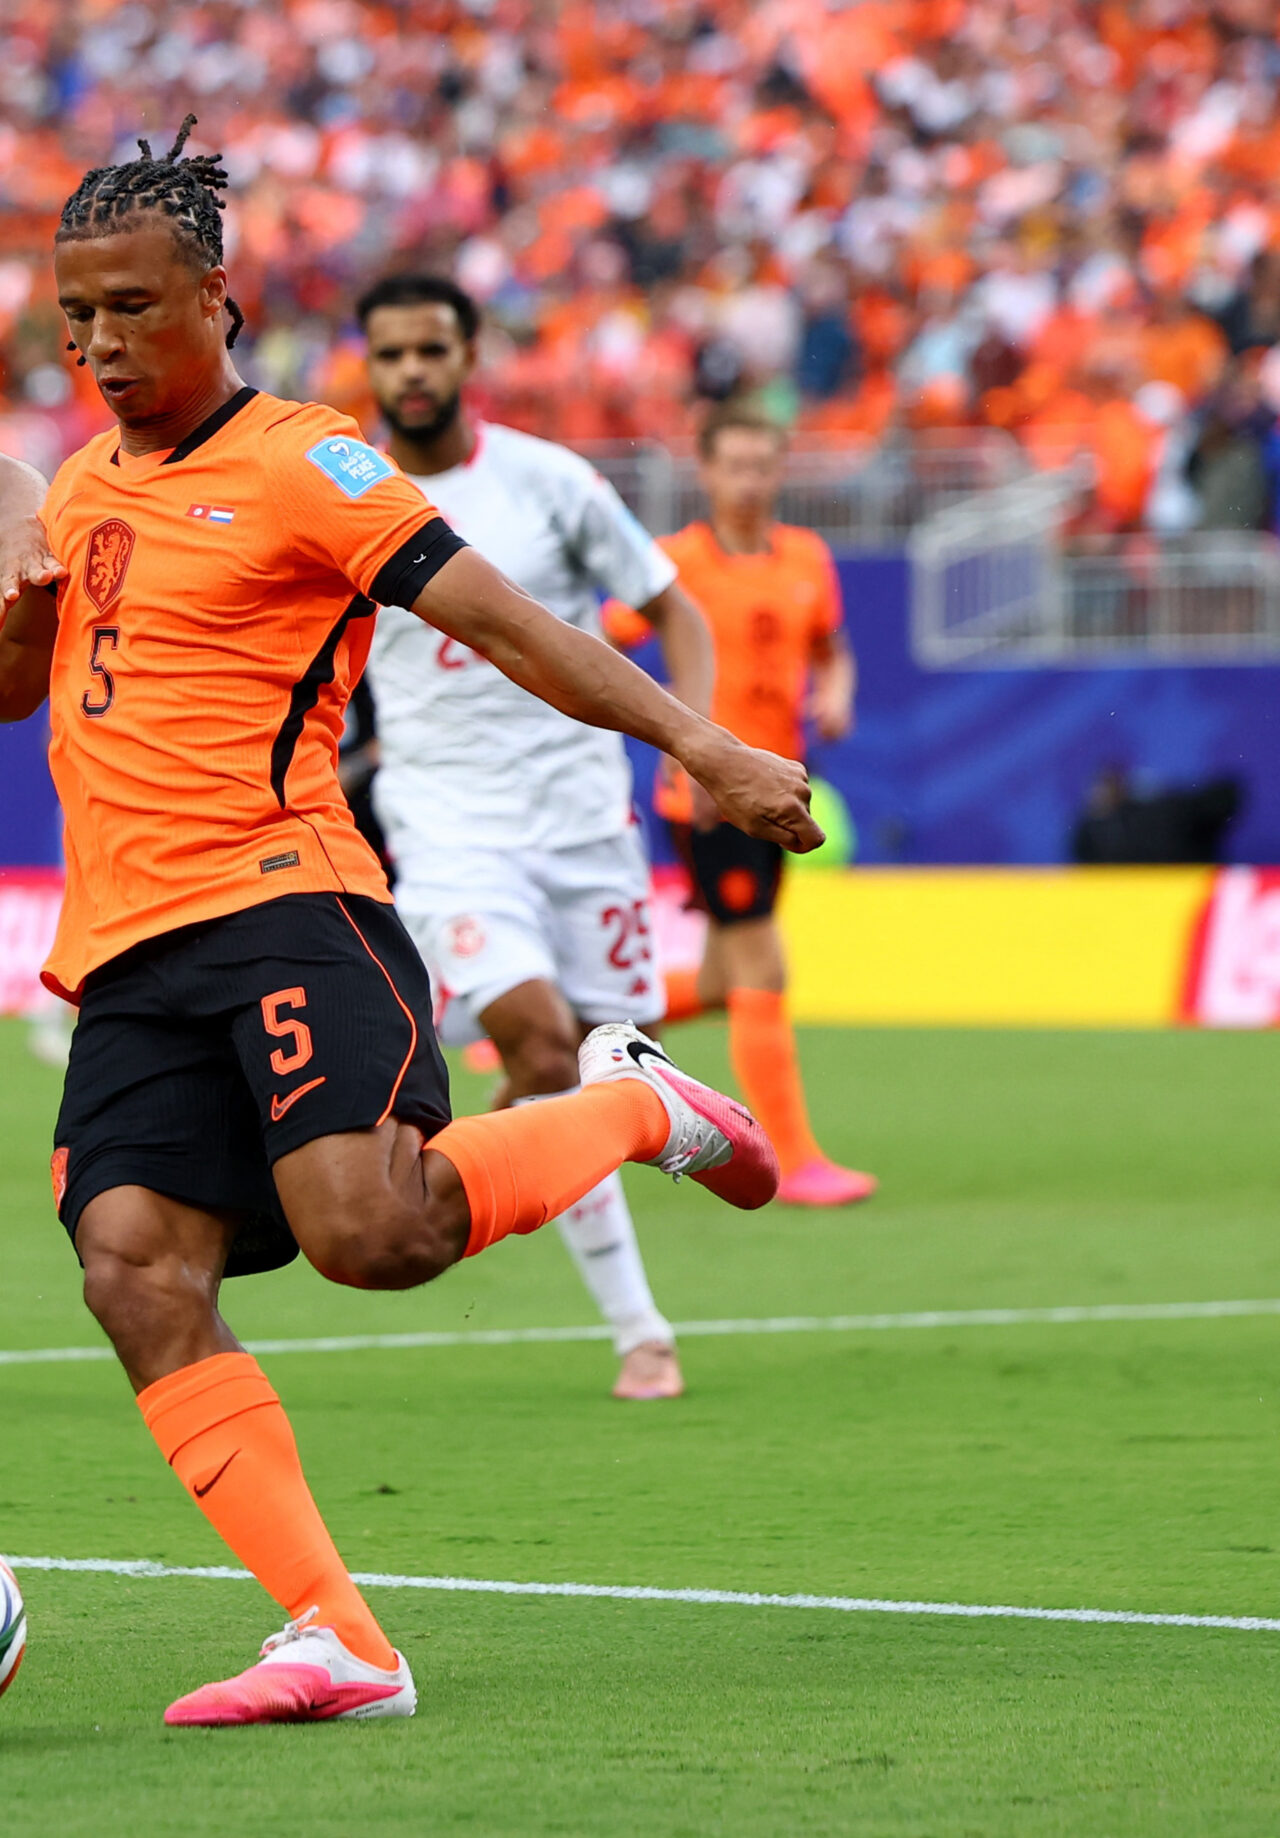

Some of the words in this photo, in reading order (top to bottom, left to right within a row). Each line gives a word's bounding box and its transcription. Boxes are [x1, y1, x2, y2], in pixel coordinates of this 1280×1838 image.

[80, 625, 120, 718] 5
[601, 900, 651, 972] 25
[260, 986, 313, 1076] 5
